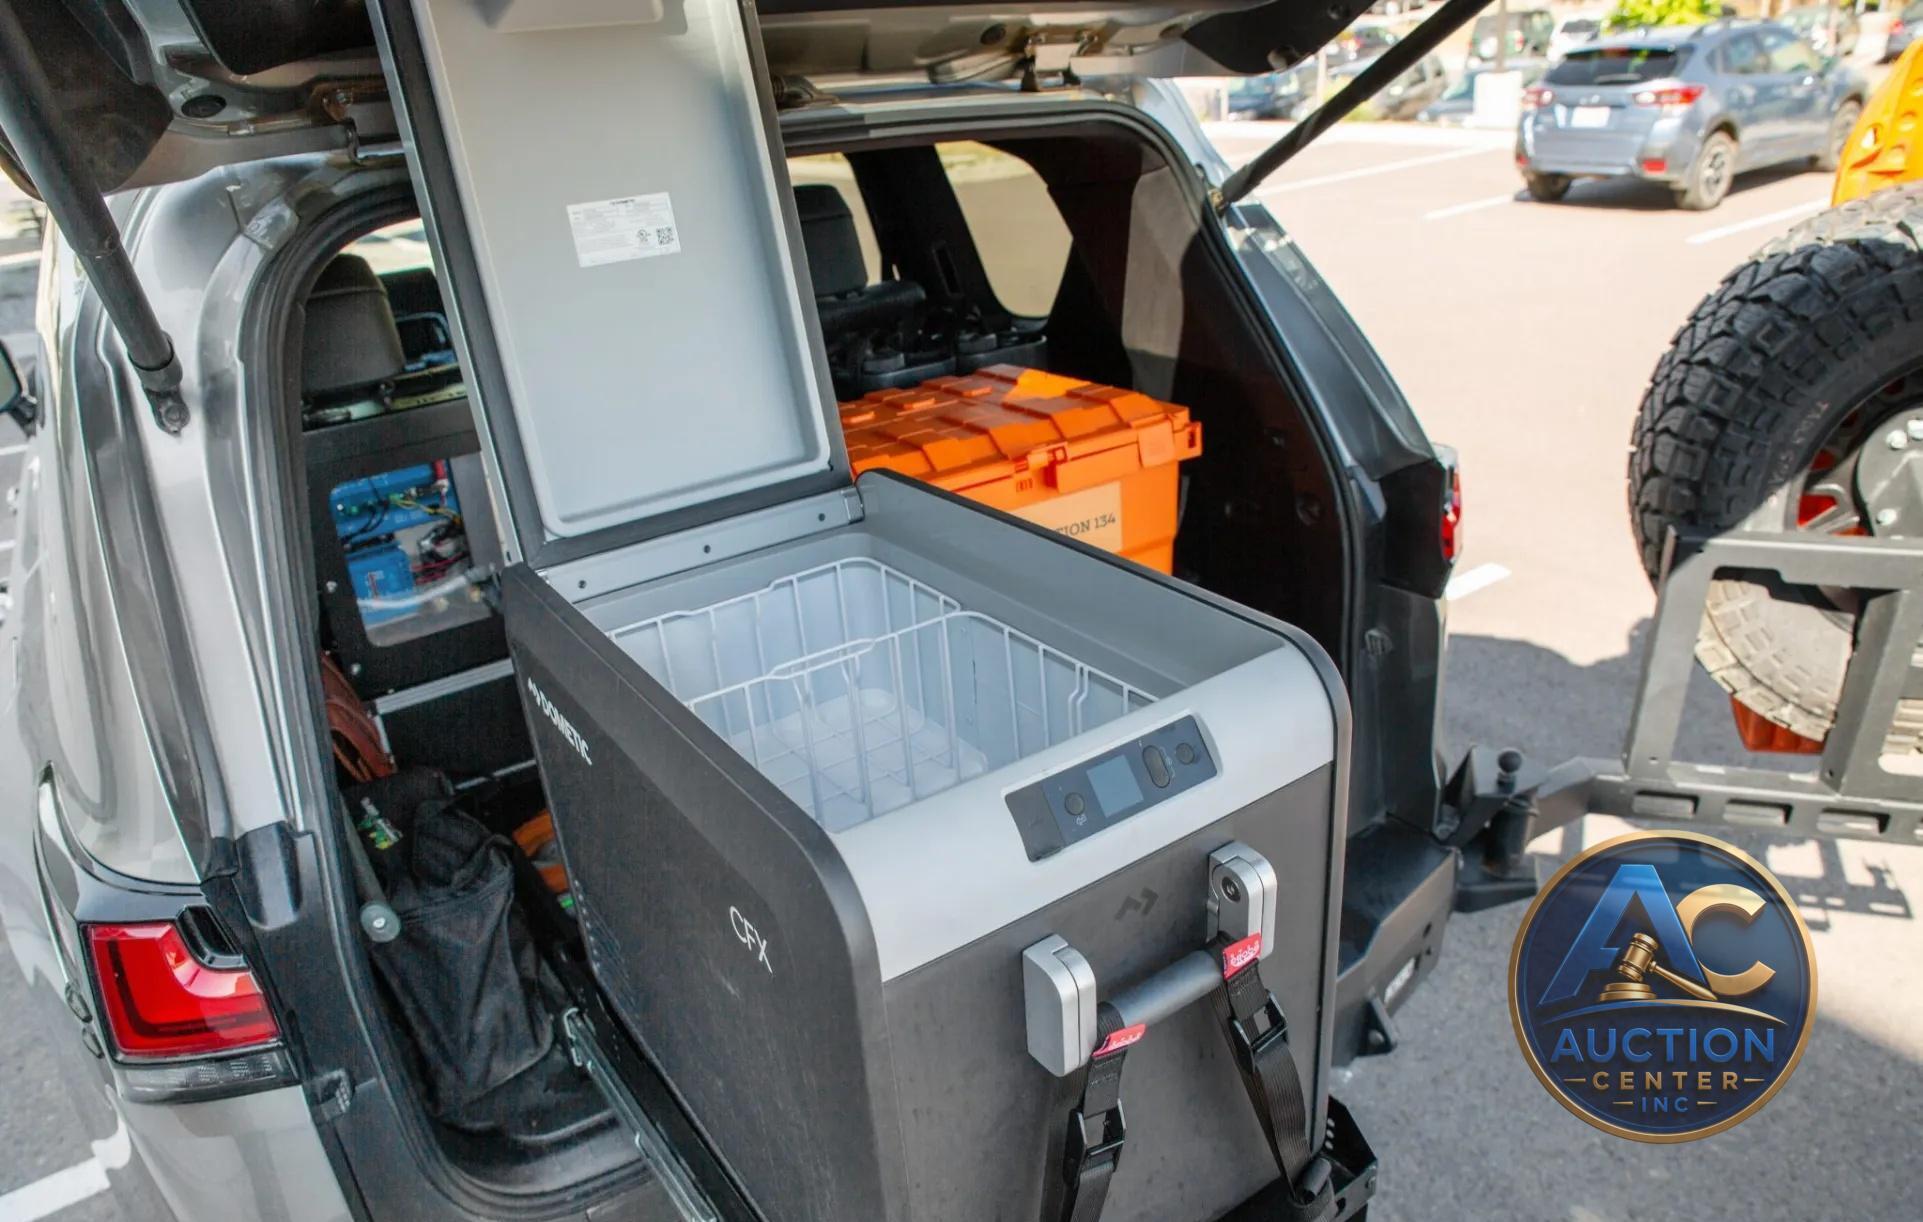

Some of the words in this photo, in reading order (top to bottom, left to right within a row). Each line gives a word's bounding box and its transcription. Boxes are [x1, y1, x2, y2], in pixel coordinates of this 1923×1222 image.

[1094, 512, 1116, 529] 134
[540, 690, 592, 765] DOMETIC
[728, 905, 774, 975] CFX
